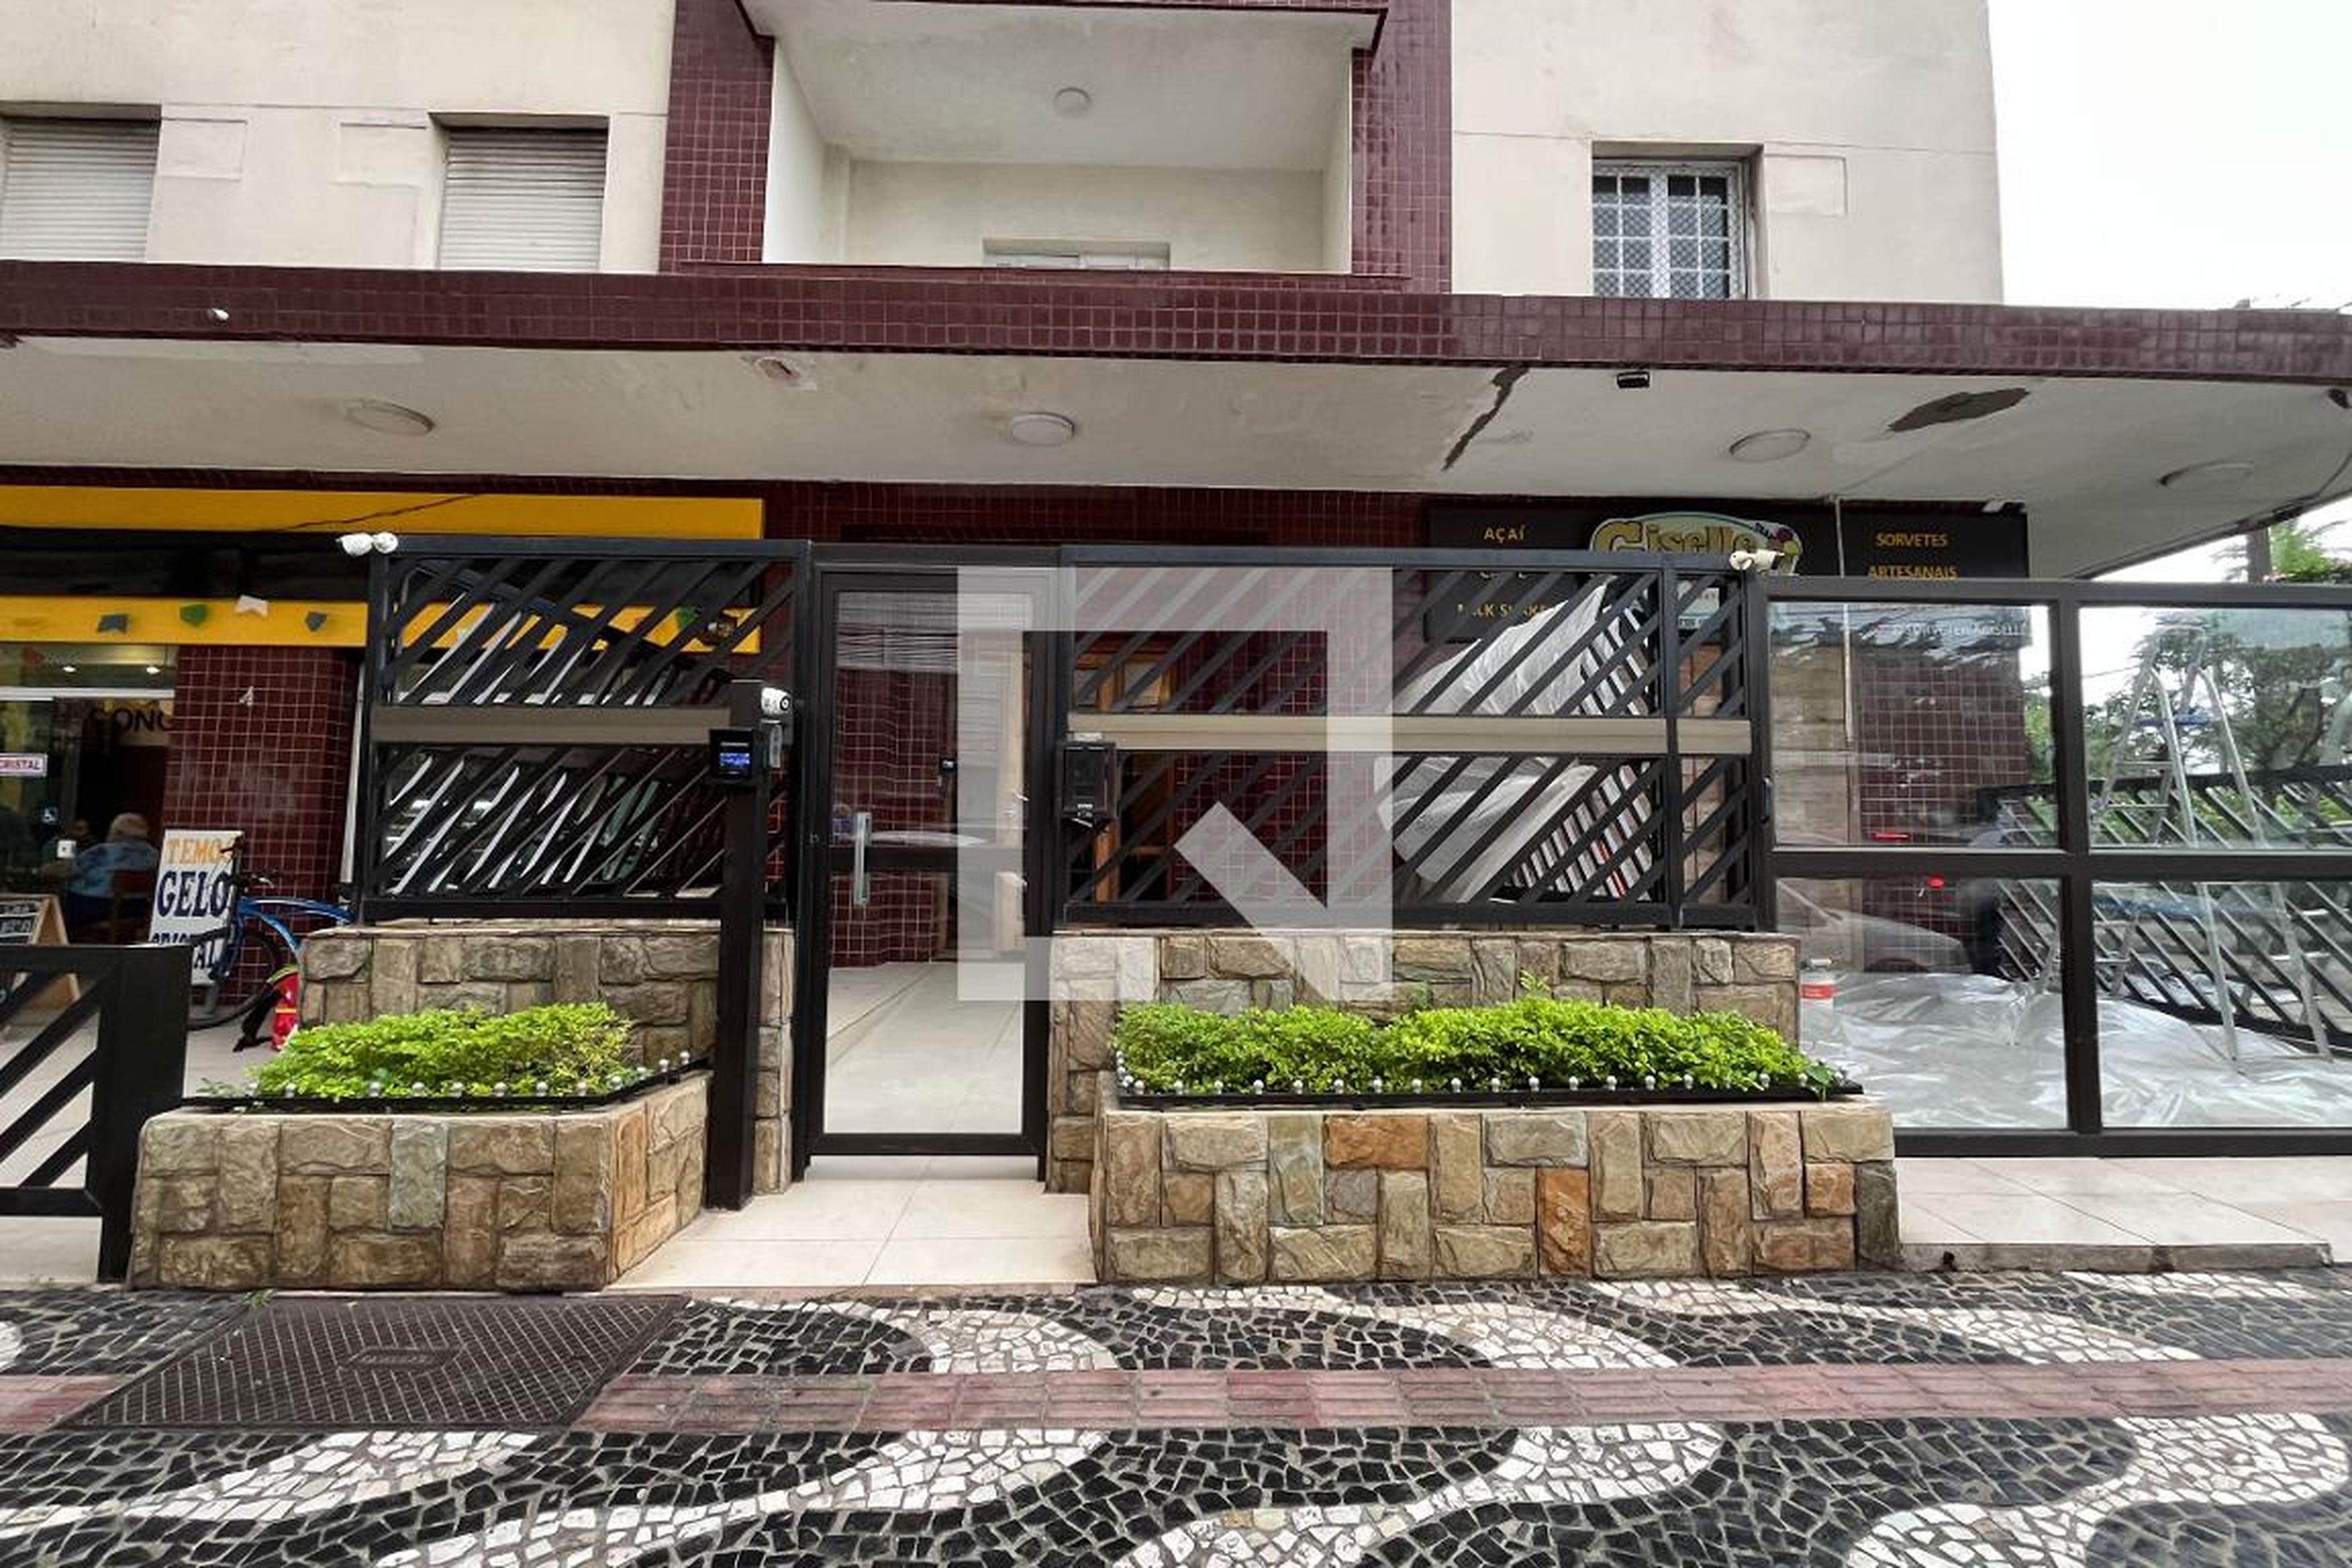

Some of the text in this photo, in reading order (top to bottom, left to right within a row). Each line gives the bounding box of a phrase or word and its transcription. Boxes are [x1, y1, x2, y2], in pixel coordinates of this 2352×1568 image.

[1483, 525, 1525, 544] AÇAÍ
[1594, 521, 1757, 552] Giselle
[1876, 532, 1948, 547] SORVETES
[1868, 565, 1959, 579] ARTESANAIS
[157, 870, 228, 918] GELO
